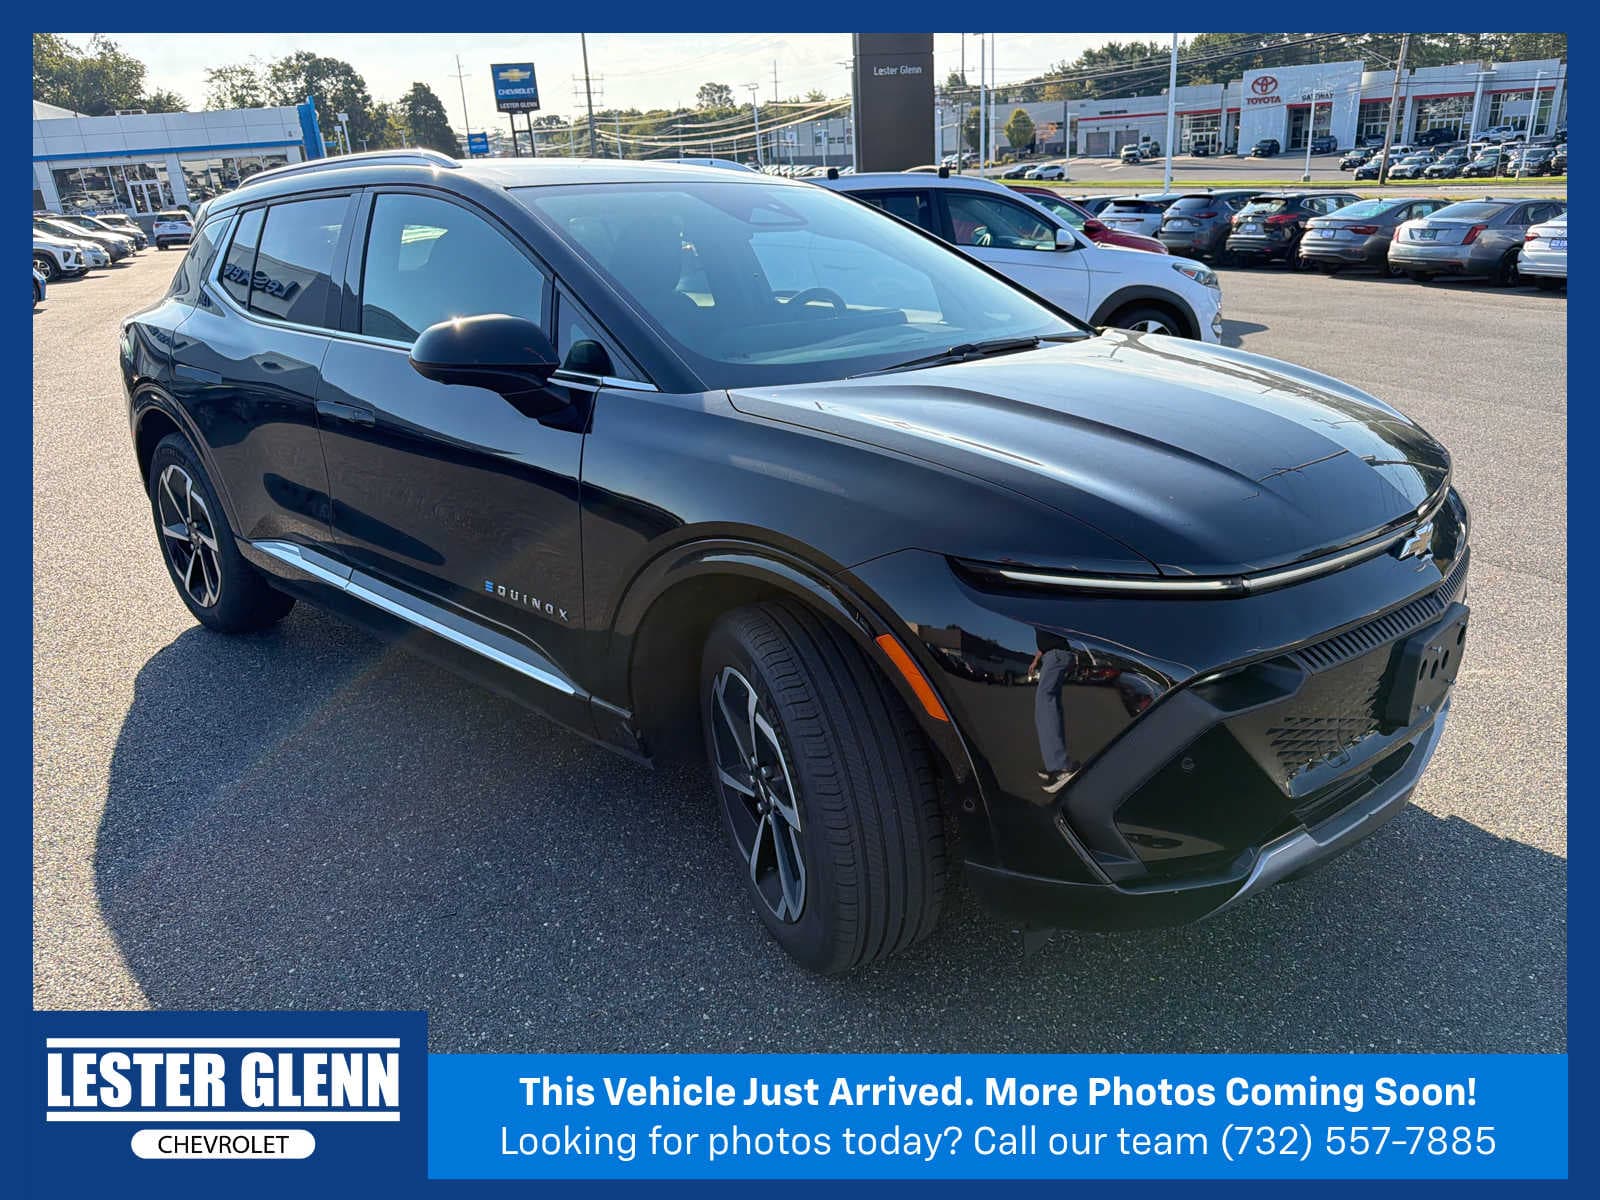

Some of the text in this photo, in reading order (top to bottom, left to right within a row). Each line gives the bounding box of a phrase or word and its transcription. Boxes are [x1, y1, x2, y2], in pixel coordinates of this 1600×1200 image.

[873, 65, 922, 76] Lester Glenn
[498, 88, 535, 96] CHEVROLET
[1246, 96, 1280, 105] TOYOTA
[484, 580, 569, 622] EQUINOX
